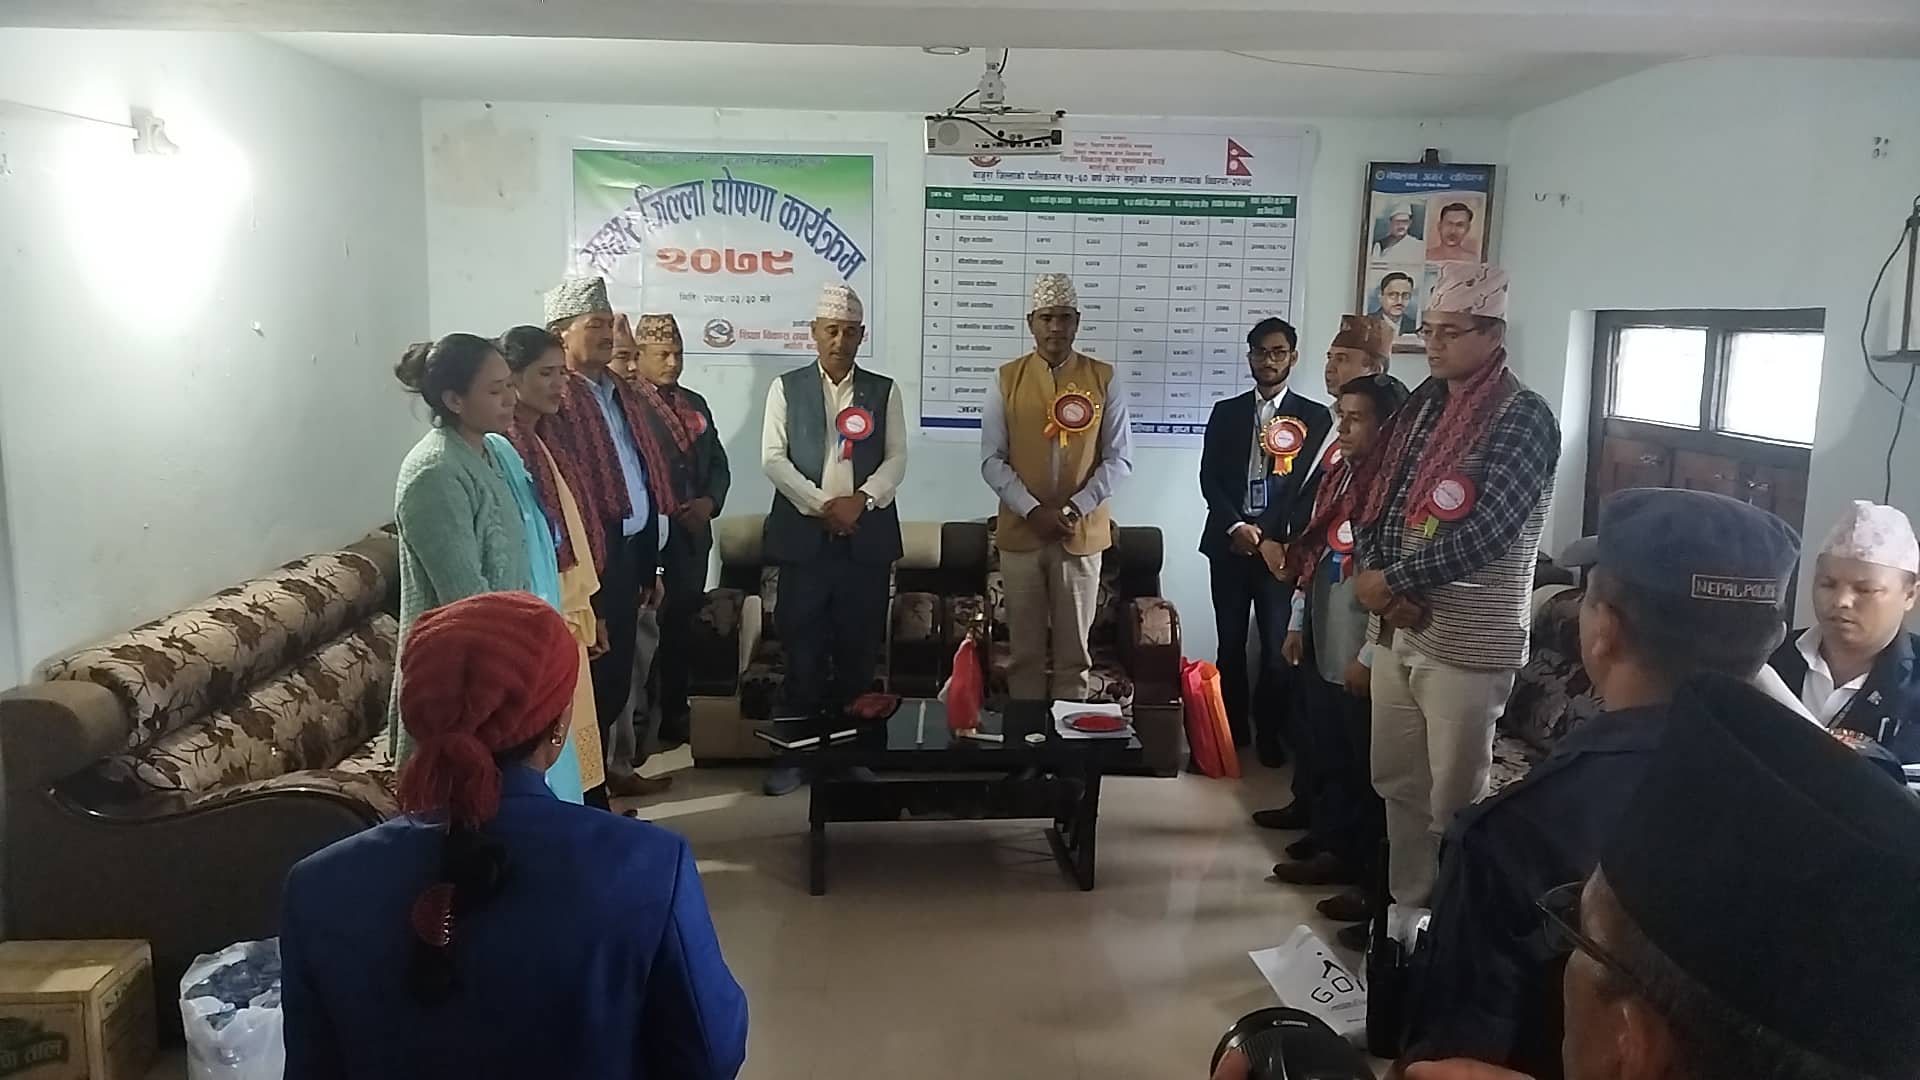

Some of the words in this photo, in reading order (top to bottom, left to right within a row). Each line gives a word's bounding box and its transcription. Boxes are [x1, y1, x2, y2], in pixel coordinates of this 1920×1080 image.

[634, 184, 706, 229] जिल्ला
[711, 166, 778, 222] घोषणा
[779, 193, 867, 280] कार्यक्रम
[656, 248, 794, 275] २०७९
[1696, 580, 1742, 598] NEPAL
